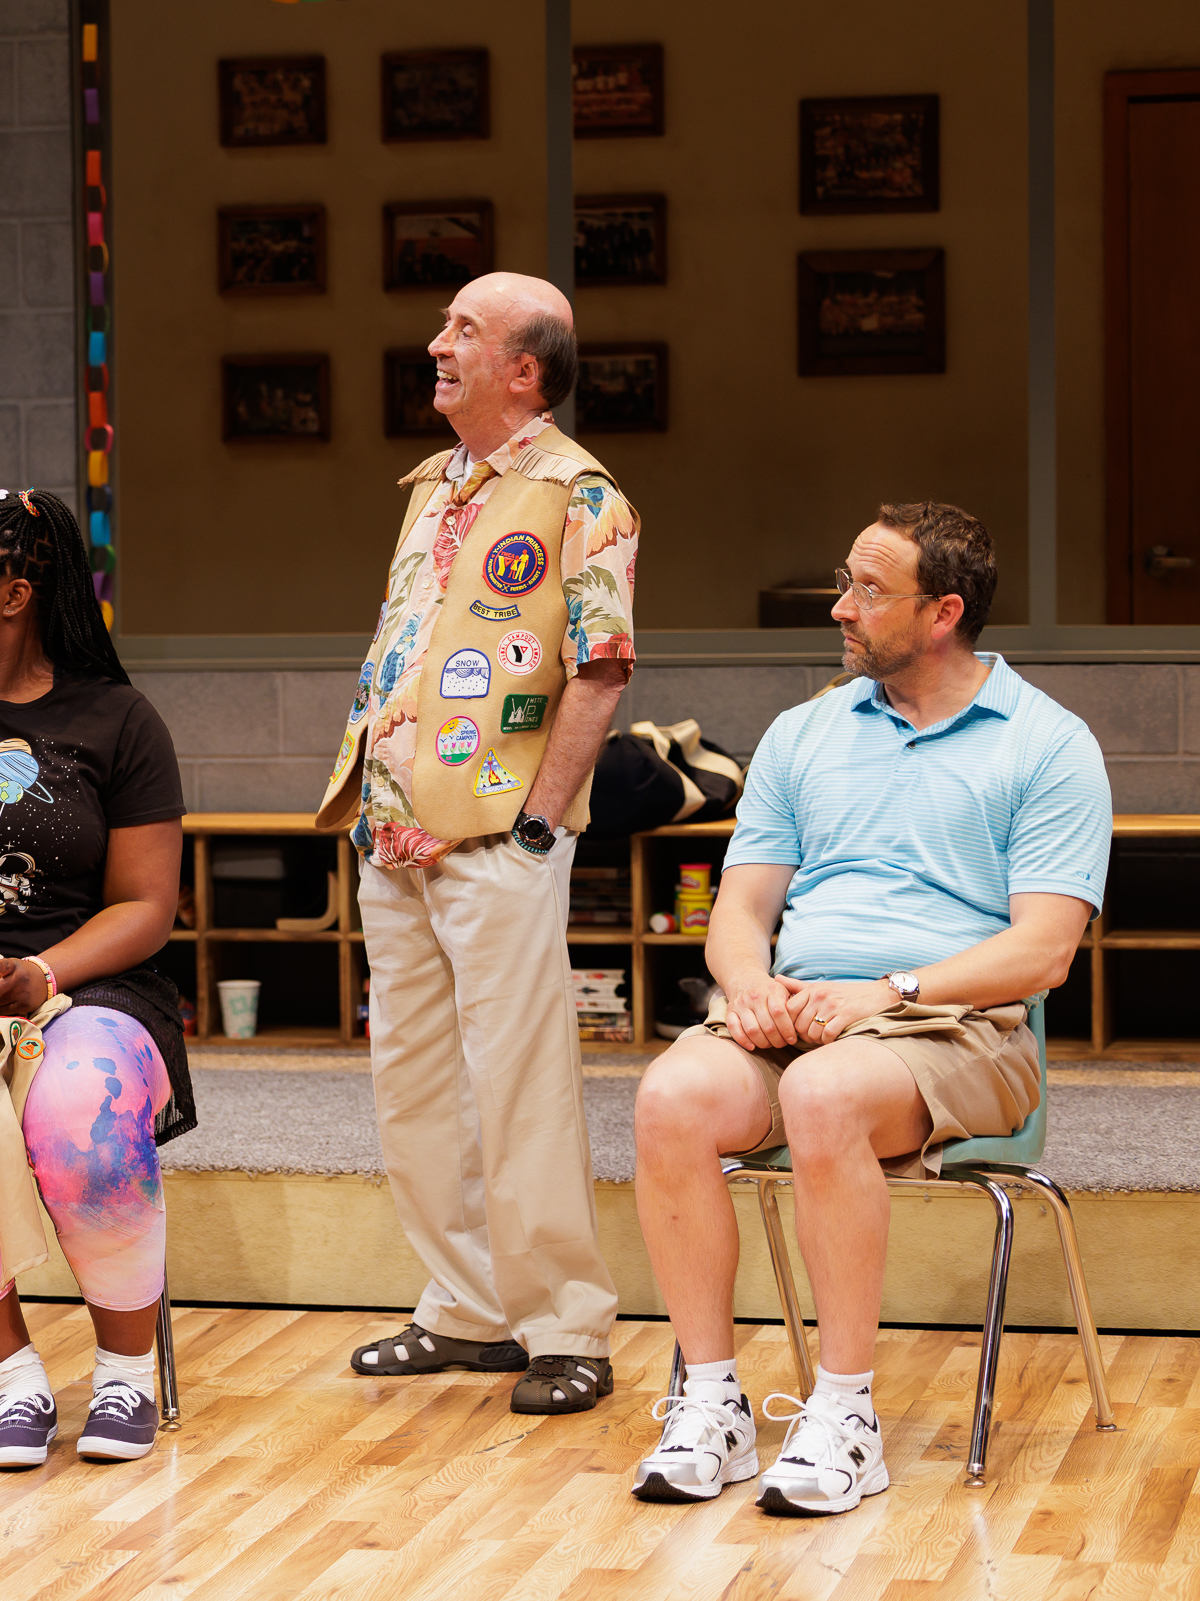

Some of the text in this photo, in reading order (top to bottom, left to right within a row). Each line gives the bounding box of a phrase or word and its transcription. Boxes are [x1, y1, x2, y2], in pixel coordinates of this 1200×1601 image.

[493, 535, 544, 566] Y-INDIAN PRINCESS
[472, 603, 517, 618] BEST TRIBE
[507, 634, 535, 644] CAMPOUT
[529, 648, 538, 667] AWARD
[847, 1445, 867, 1469] N
